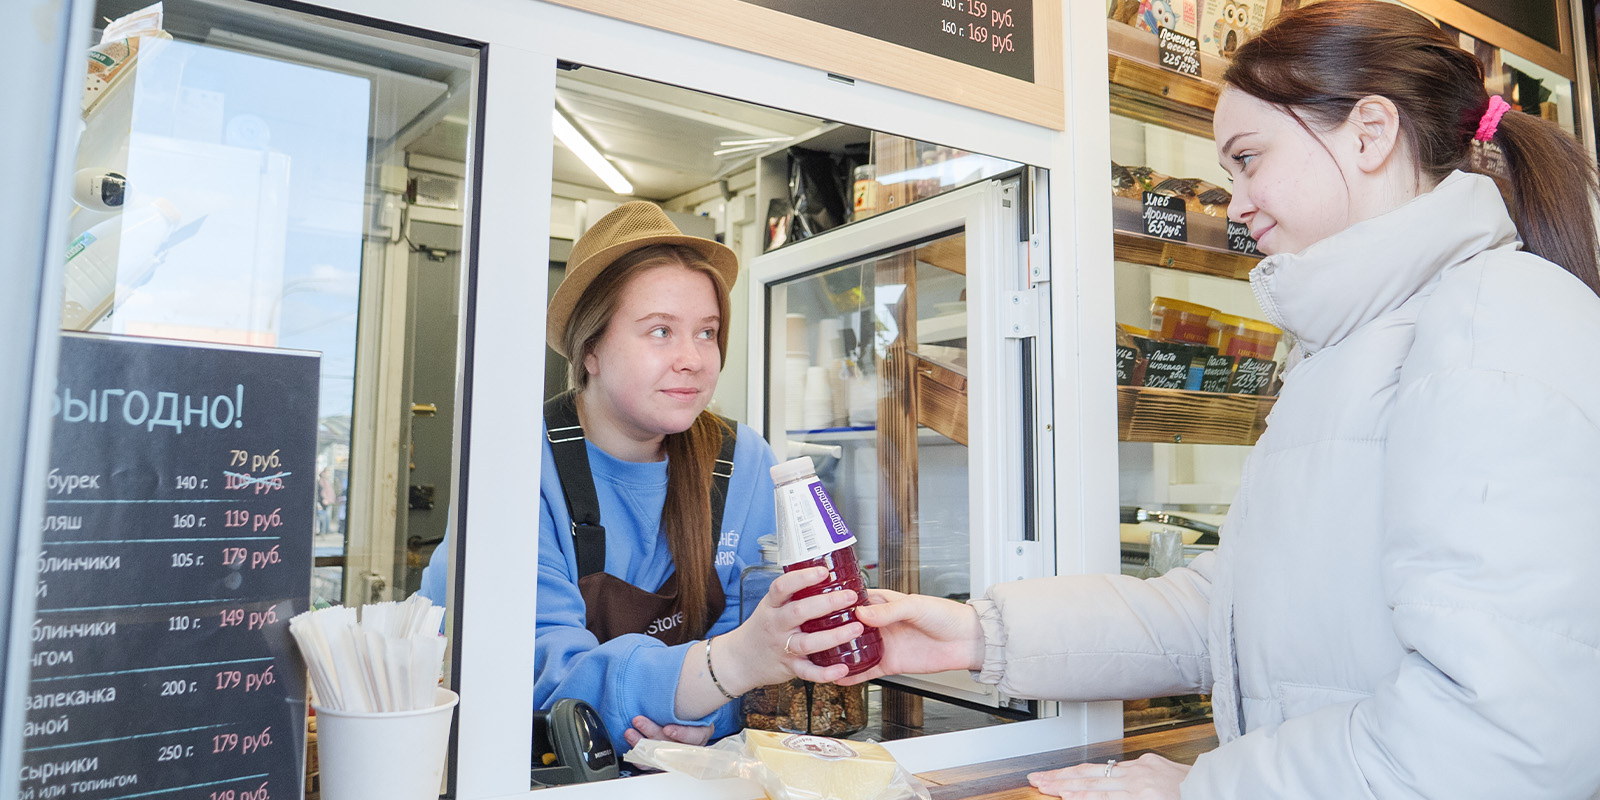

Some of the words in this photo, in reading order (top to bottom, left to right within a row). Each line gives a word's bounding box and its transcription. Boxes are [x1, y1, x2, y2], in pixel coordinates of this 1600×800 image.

[967, 0, 988, 18] 159
[991, 8, 1015, 29] руб.
[941, 19, 957, 35] 160
[958, 27, 965, 37] г.
[967, 22, 988, 43] 169
[991, 33, 1015, 54] руб.
[1159, 28, 1197, 50] Печенье
[1144, 192, 1170, 207] Хлеб
[1151, 349, 1177, 362] Паста
[229, 449, 248, 467] 79
[251, 448, 282, 473] руб.
[47, 468, 101, 495] бурек
[175, 475, 197, 490] 140
[199, 478, 209, 489] г.
[172, 513, 196, 529] 160
[197, 516, 207, 528] г.
[224, 509, 250, 528] 119
[253, 507, 284, 532] руб.
[37, 550, 121, 574] блинчики
[171, 552, 193, 568] 105
[195, 555, 205, 566] г.
[221, 547, 248, 566] 179
[251, 544, 282, 570] руб.
[31, 618, 116, 642] блинчики
[168, 615, 190, 631] 110
[192, 617, 201, 629] г.
[219, 608, 245, 627] 149
[248, 604, 279, 631] руб.
[647, 611, 684, 635] Store
[25, 686, 116, 711] запеканка
[160, 679, 187, 697] 200
[189, 681, 198, 693] г.
[215, 670, 242, 690] 179
[245, 664, 276, 693] руб.
[23, 714, 69, 737] аной
[18, 756, 99, 785] сырники
[157, 744, 183, 762] 250
[185, 745, 194, 758] г.
[212, 732, 239, 754] 179
[242, 725, 273, 755] руб.
[38, 784, 67, 799] или
[70, 774, 138, 793] топингом
